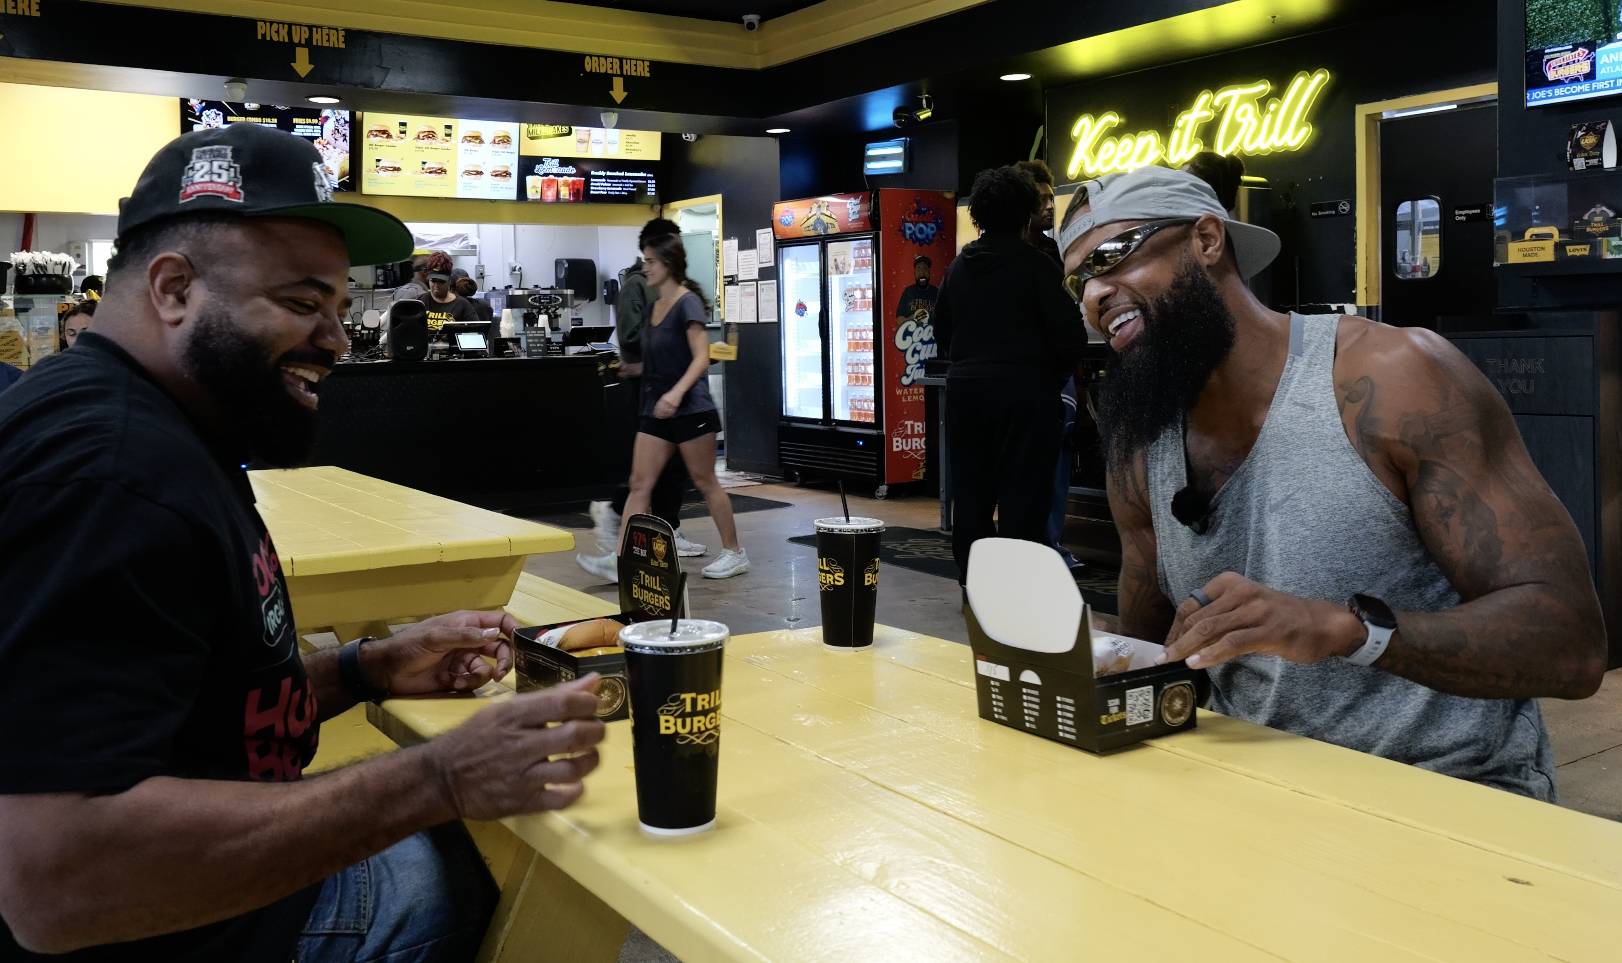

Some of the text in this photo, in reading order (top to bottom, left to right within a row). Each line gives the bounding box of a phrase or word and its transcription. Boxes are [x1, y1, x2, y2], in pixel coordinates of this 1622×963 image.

[257, 21, 345, 48] PICK UP HERE
[584, 56, 650, 77] ORDER HERE
[1531, 89, 1553, 100] JOE'S
[1554, 83, 1591, 97] BECOME
[1592, 80, 1616, 91] FIRST
[1067, 69, 1328, 179] Keep it Trill
[193, 161, 229, 183] 25
[905, 222, 937, 240] POP
[895, 320, 935, 350] Coo
[1486, 359, 1545, 373] THANK
[1498, 379, 1535, 394] YOU
[639, 570, 662, 592] TRILL
[632, 584, 670, 610] BURGERS
